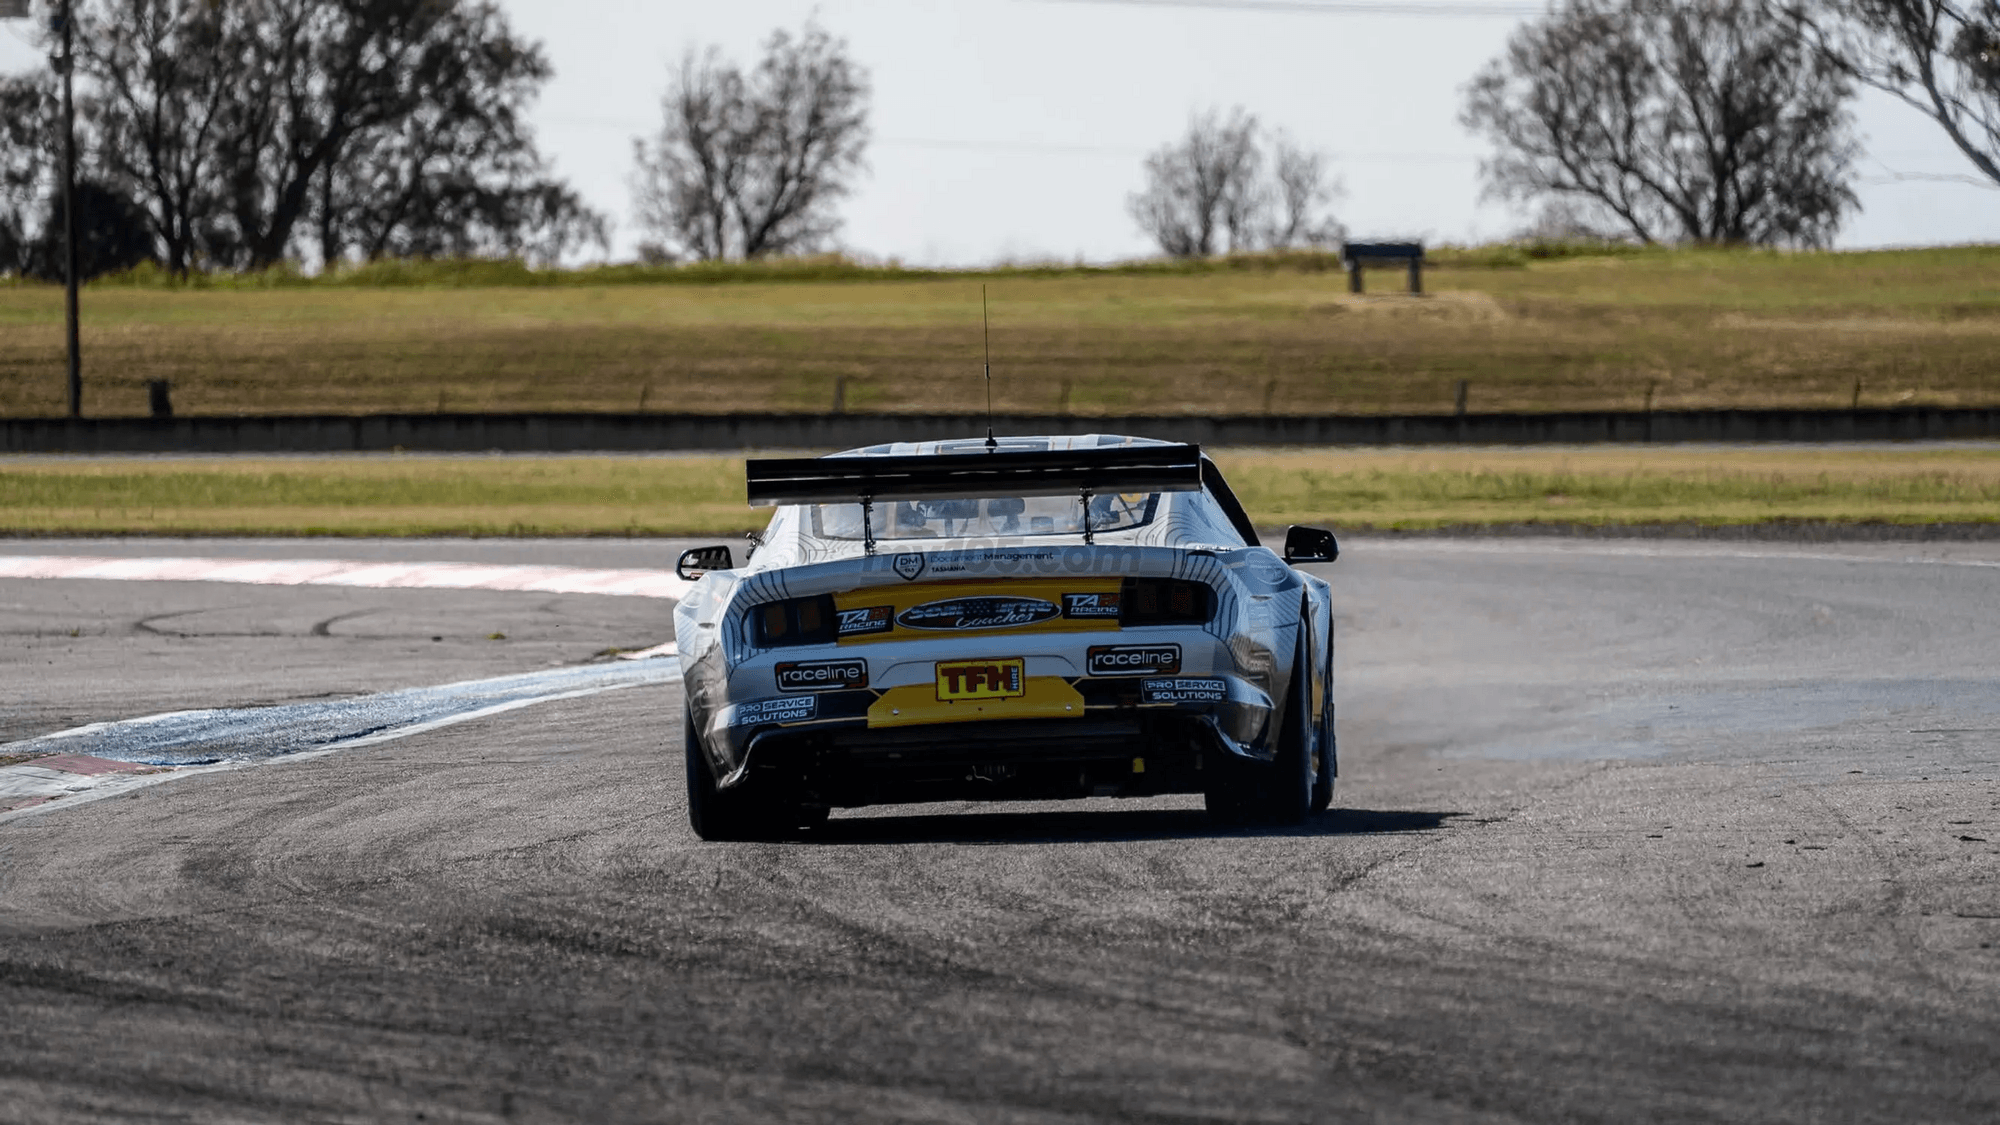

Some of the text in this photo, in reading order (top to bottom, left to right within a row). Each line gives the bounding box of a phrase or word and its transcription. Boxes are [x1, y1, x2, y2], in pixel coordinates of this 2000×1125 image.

[900, 556, 918, 565] DM
[930, 551, 1054, 563] Document Management
[931, 564, 966, 573] TASMANIA
[839, 619, 887, 630] RACING
[955, 611, 1034, 629] Coaches
[1095, 651, 1174, 665] raceline
[783, 666, 860, 681] raceline
[941, 665, 1019, 694] TFH HIRE
[1147, 680, 1225, 690] PRO SERVICE
[1152, 691, 1223, 700] SOLUTIONS
[739, 697, 814, 715] PRO SERVICE
[741, 709, 807, 725] SOLUTIONS
